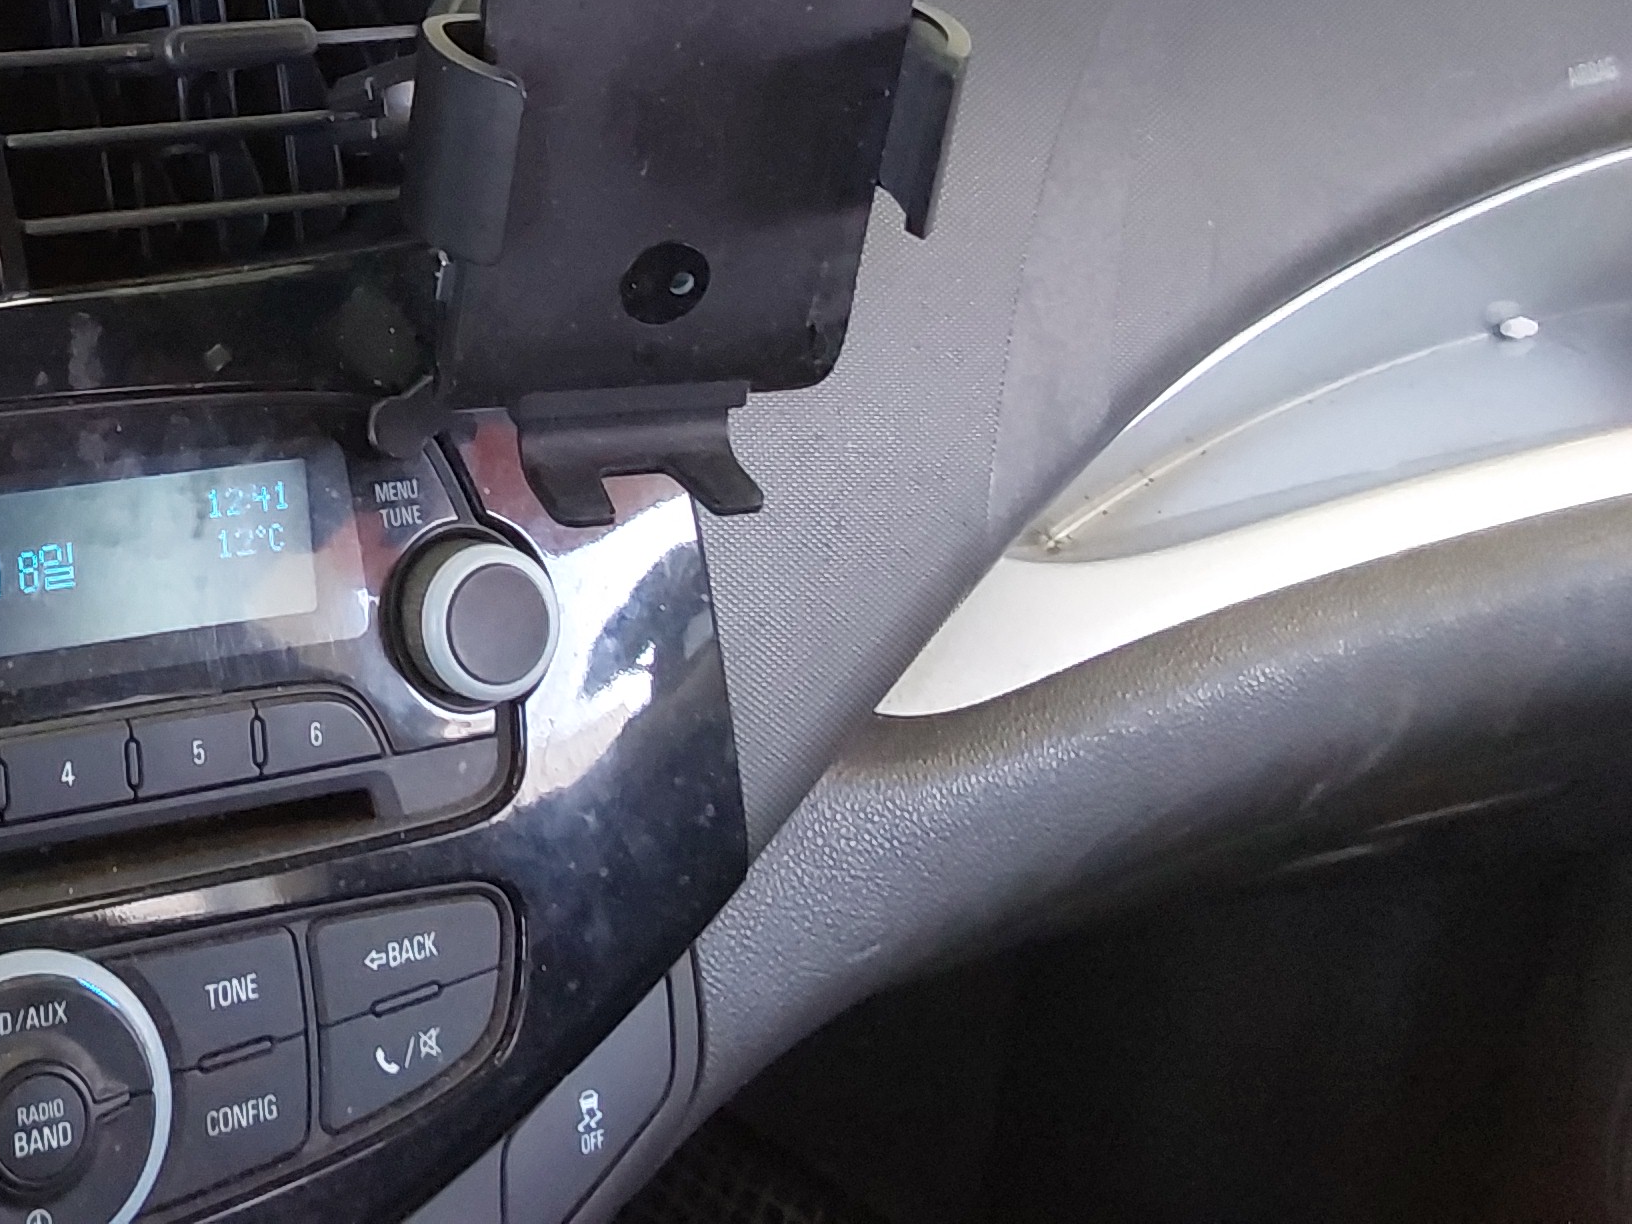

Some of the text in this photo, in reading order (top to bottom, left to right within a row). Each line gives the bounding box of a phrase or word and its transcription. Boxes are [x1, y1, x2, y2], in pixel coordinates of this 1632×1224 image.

[374, 478, 420, 503] MENU
[379, 504, 424, 529] TUNE
[17, 542, 76, 594] 8일
[309, 721, 324, 748] 6
[192, 739, 206, 767] 5
[60, 760, 77, 788] 4
[386, 931, 440, 966] BACK
[203, 973, 260, 1011] TONE
[16, 1097, 65, 1126] RADIO
[205, 1094, 279, 1137] CONFIG
[12, 1121, 73, 1159] BAND
[580, 1129, 604, 1155] OFF
